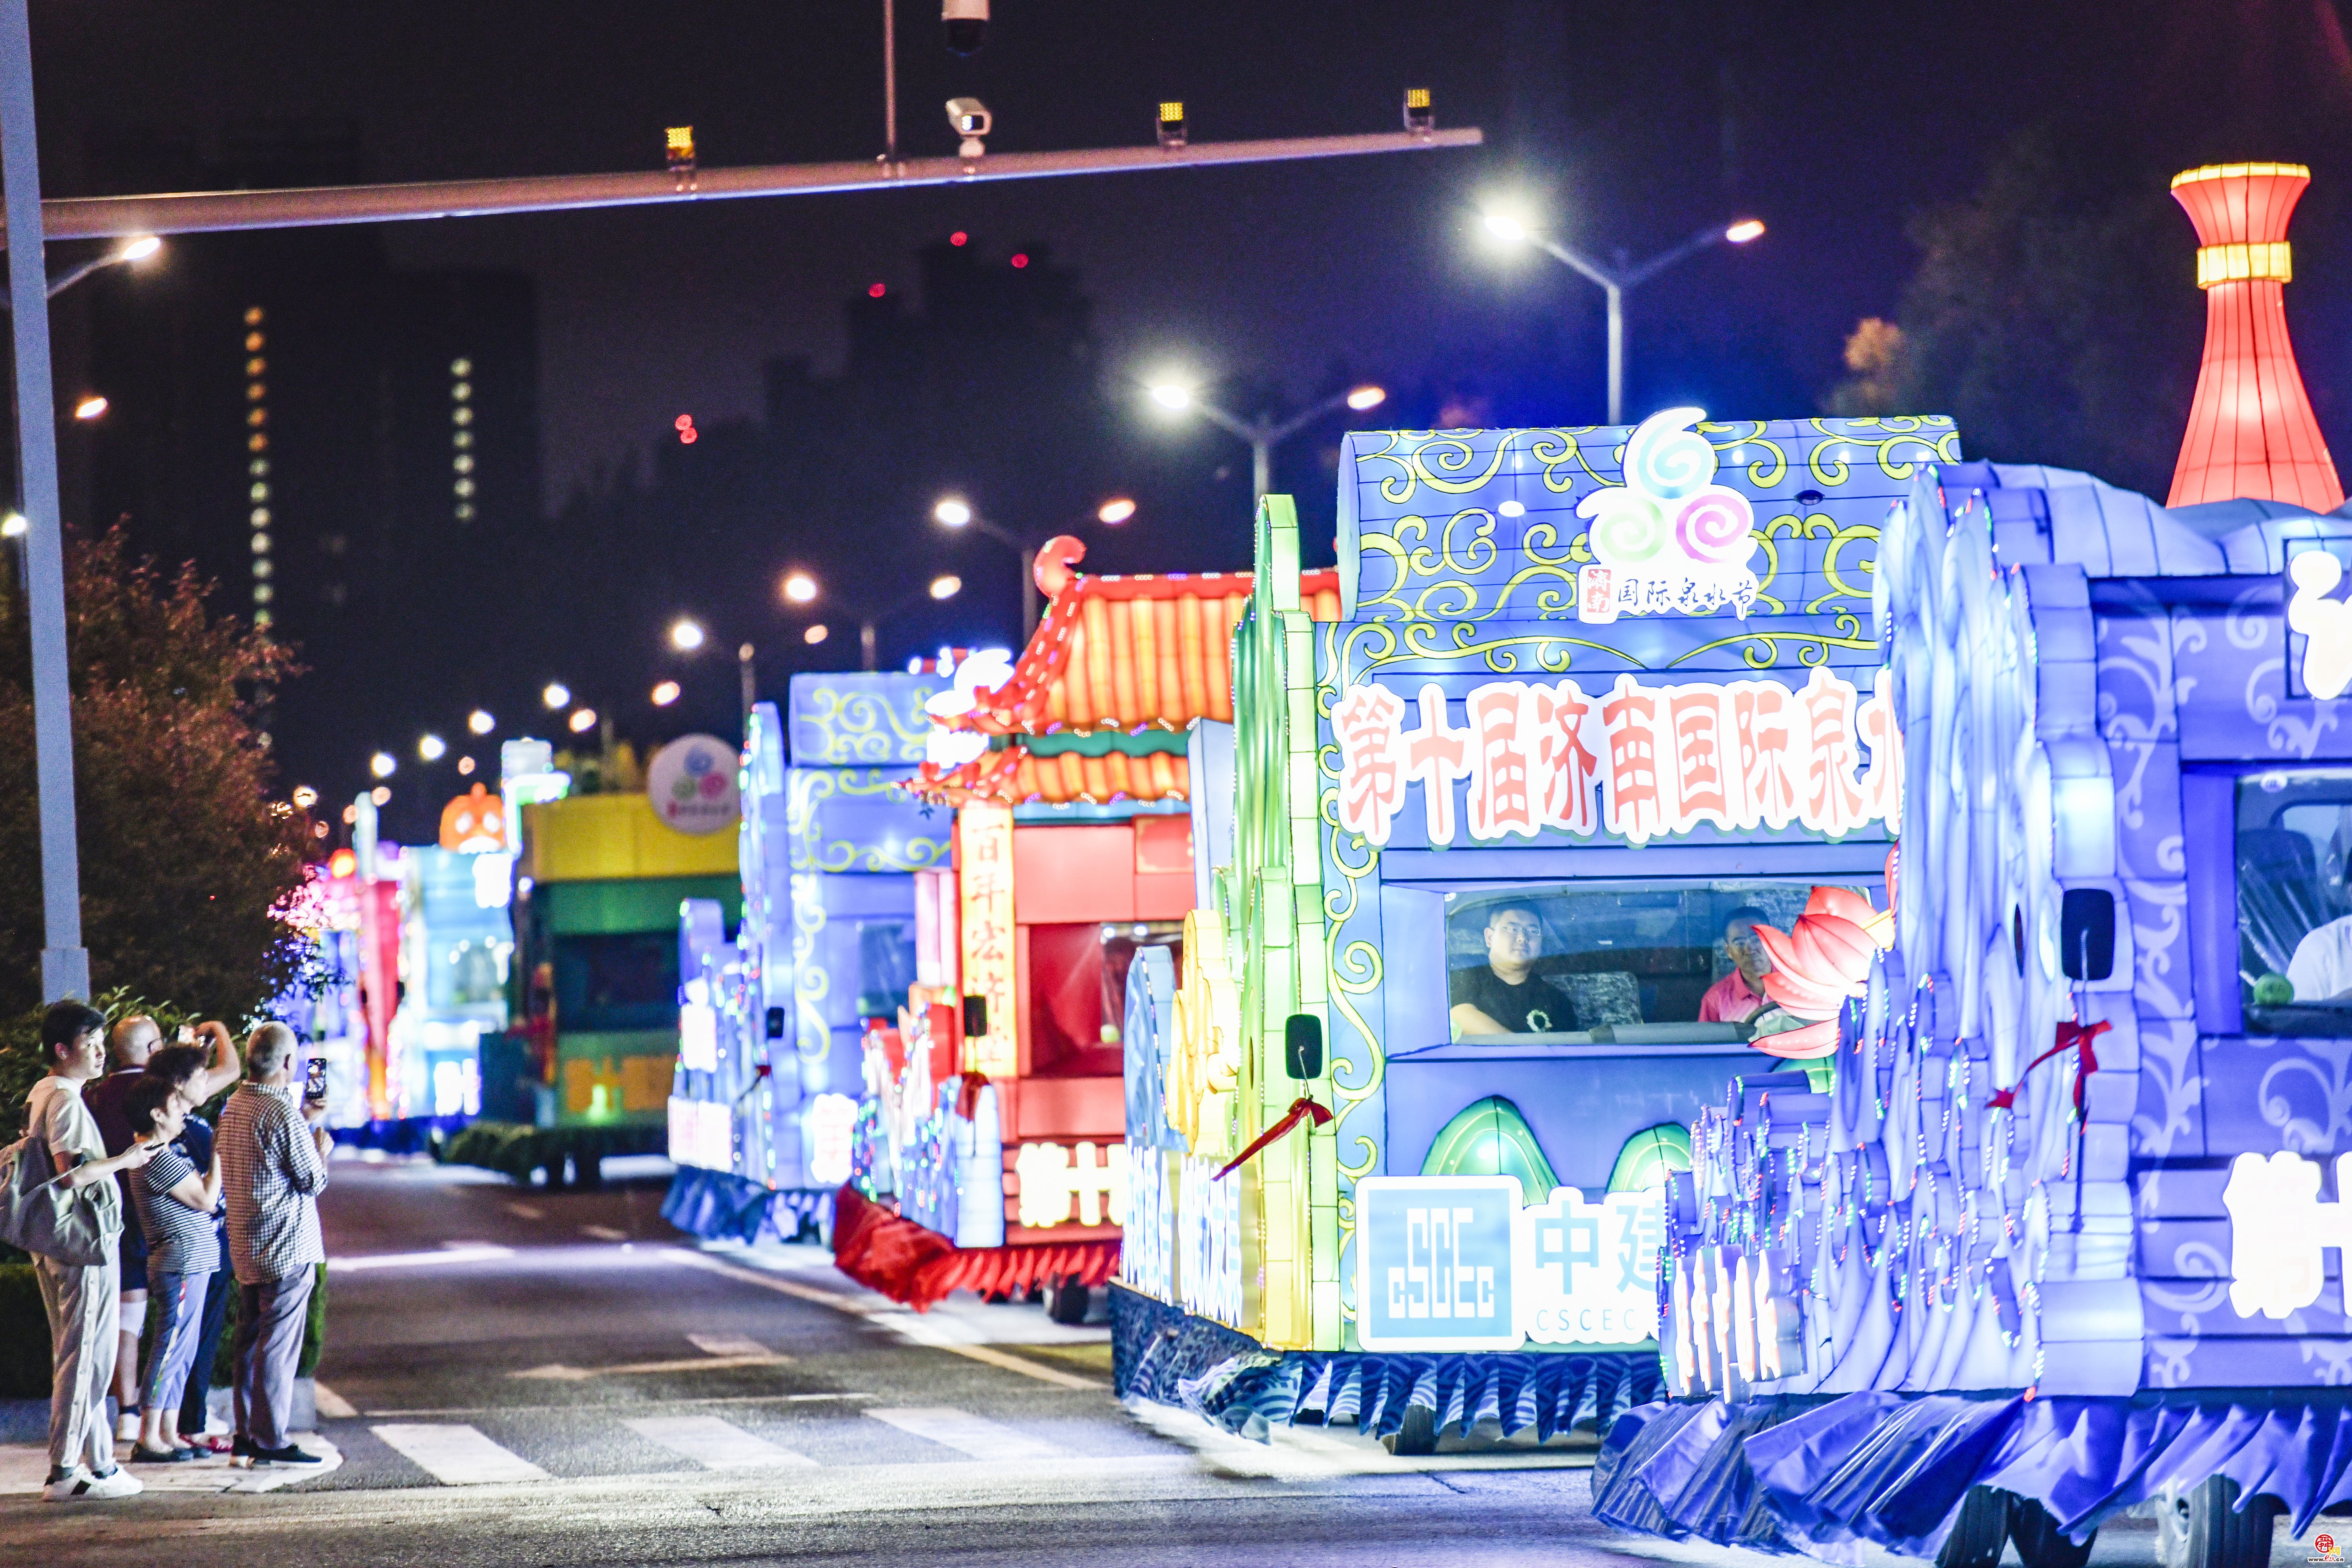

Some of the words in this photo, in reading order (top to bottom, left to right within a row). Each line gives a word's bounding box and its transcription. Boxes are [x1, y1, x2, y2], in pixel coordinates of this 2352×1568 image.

[1618, 577, 1753, 618] 国际泉水节
[1536, 1308, 1636, 1331] CSCEC
